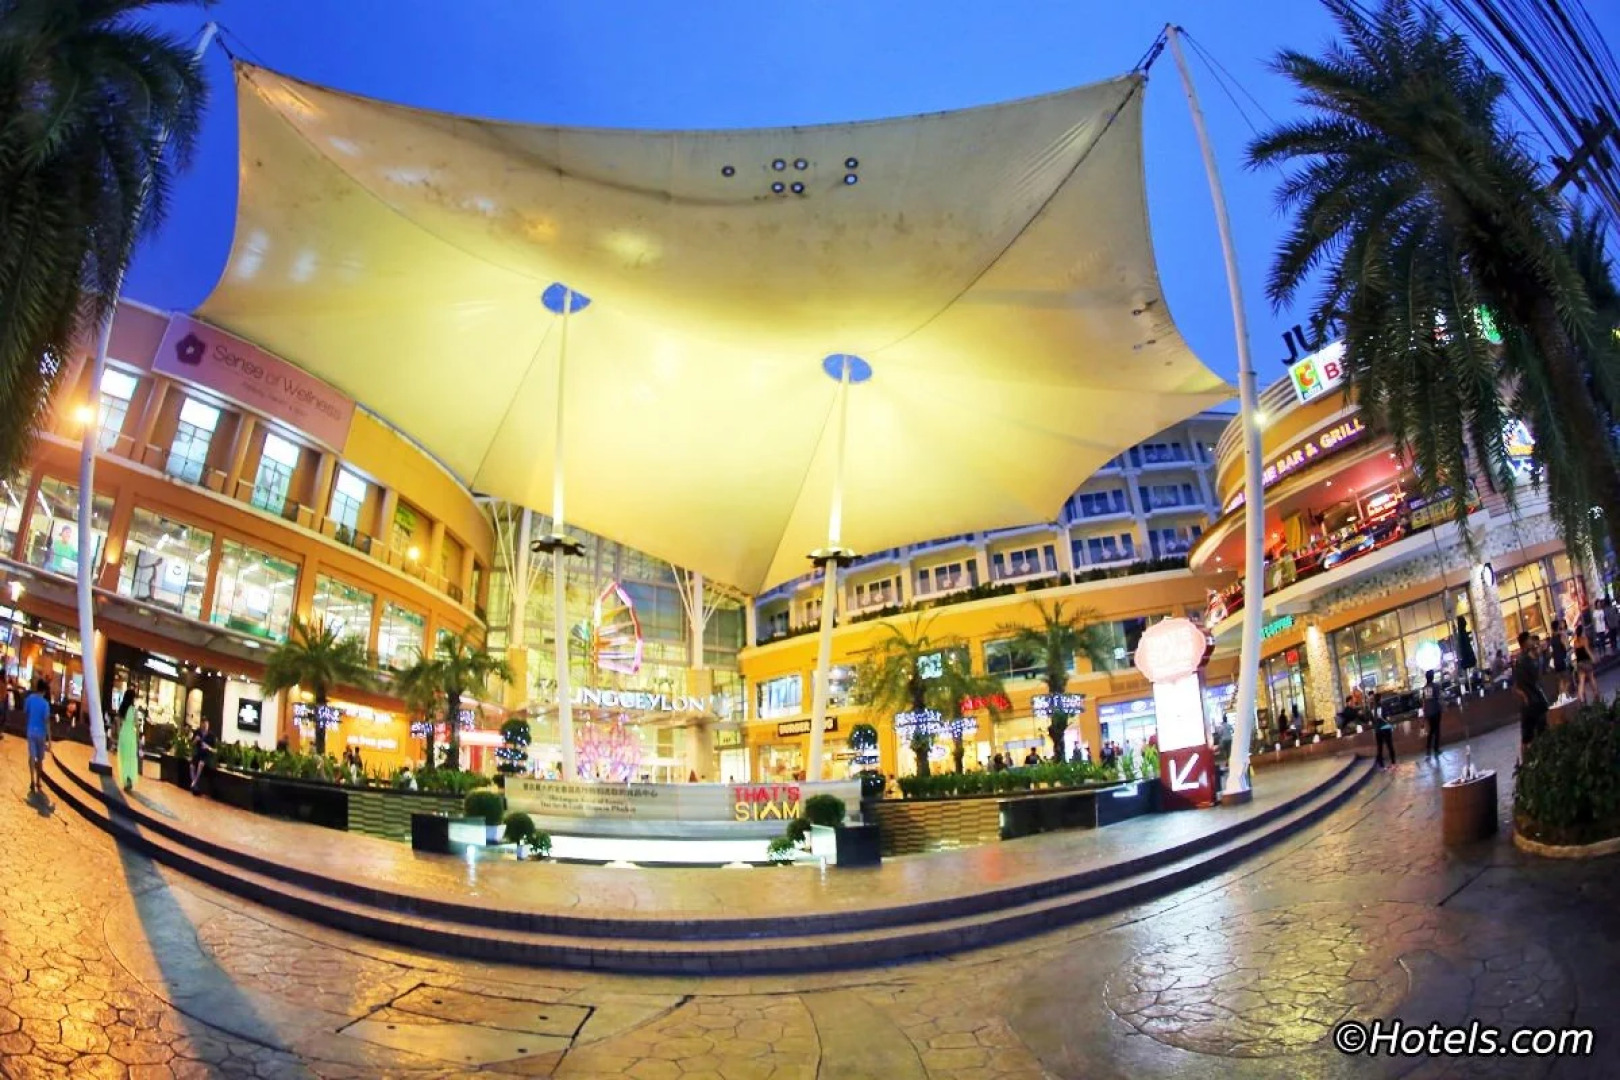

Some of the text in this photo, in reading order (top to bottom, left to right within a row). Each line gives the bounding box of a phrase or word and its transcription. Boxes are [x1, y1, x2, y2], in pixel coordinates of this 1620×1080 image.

[213, 345, 264, 379] Sense
[283, 377, 342, 421] Wellness
[1276, 417, 1366, 475] BAR & GRILL
[734, 785, 802, 802] THAT'S
[734, 800, 801, 822] SIAM
